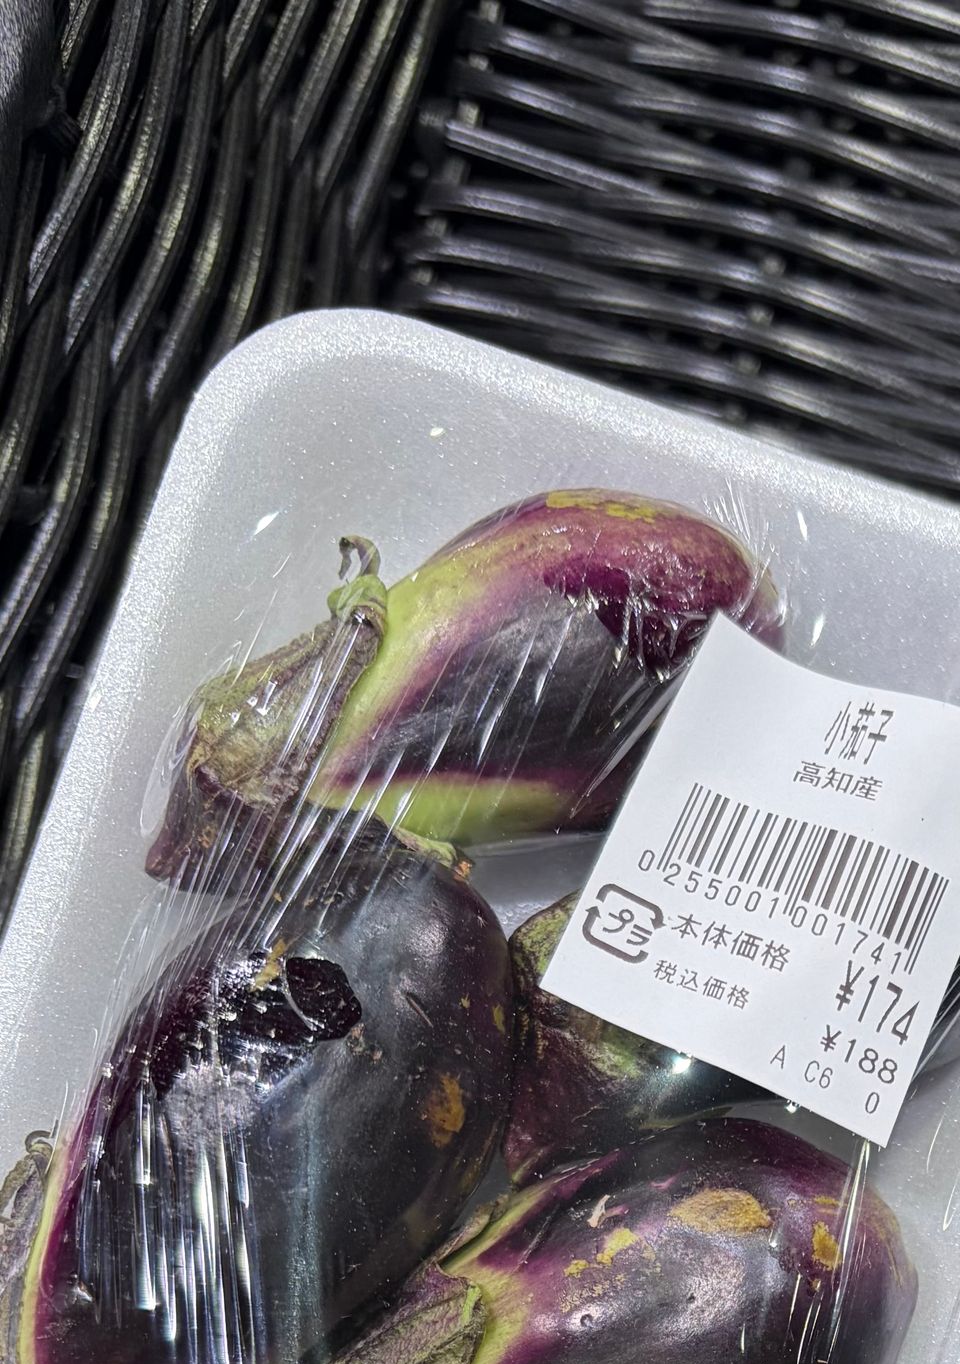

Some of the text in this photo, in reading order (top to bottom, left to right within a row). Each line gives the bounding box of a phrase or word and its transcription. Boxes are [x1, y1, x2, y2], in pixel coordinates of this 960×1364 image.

[823, 701, 894, 765] 小茄子
[792, 760, 883, 801] 高知産
[603, 907, 653, 946] プラ
[670, 913, 920, 1046] 本体価格 ¥174
[653, 958, 898, 1084] 税込価格 ¥188
[769, 1044, 787, 1071] A
[803, 1060, 834, 1090] C6
